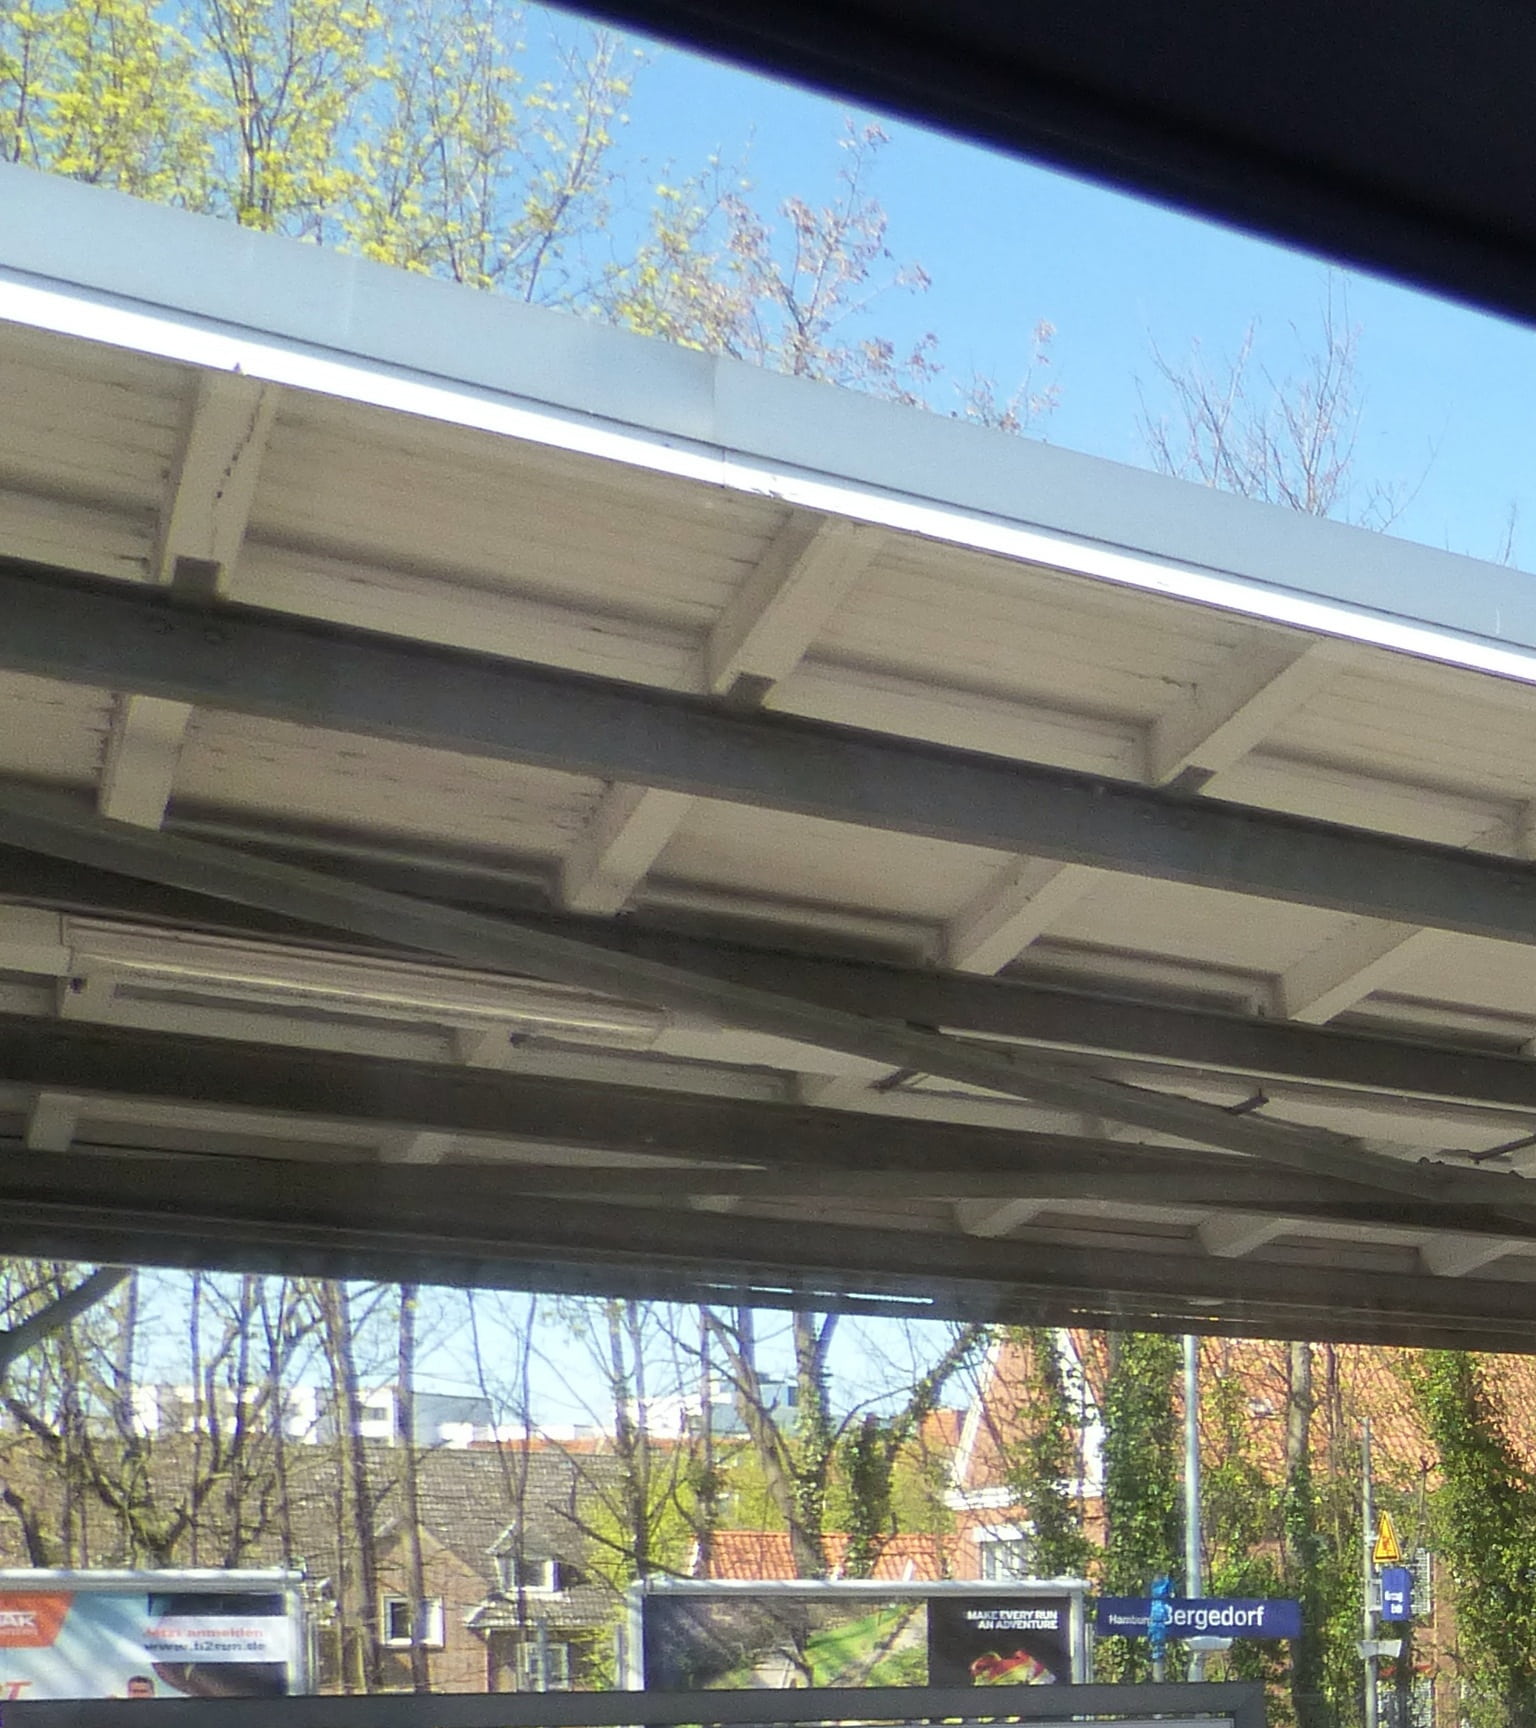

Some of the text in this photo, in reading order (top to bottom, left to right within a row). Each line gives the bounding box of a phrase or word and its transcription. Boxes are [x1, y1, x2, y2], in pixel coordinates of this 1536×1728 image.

[967, 1610, 1058, 1620] MAKE EVERY RUN
[0, 1612, 36, 1629] AK
[978, 1620, 1058, 1629] AN ADVENTURE
[187, 1627, 263, 1638] anmelden
